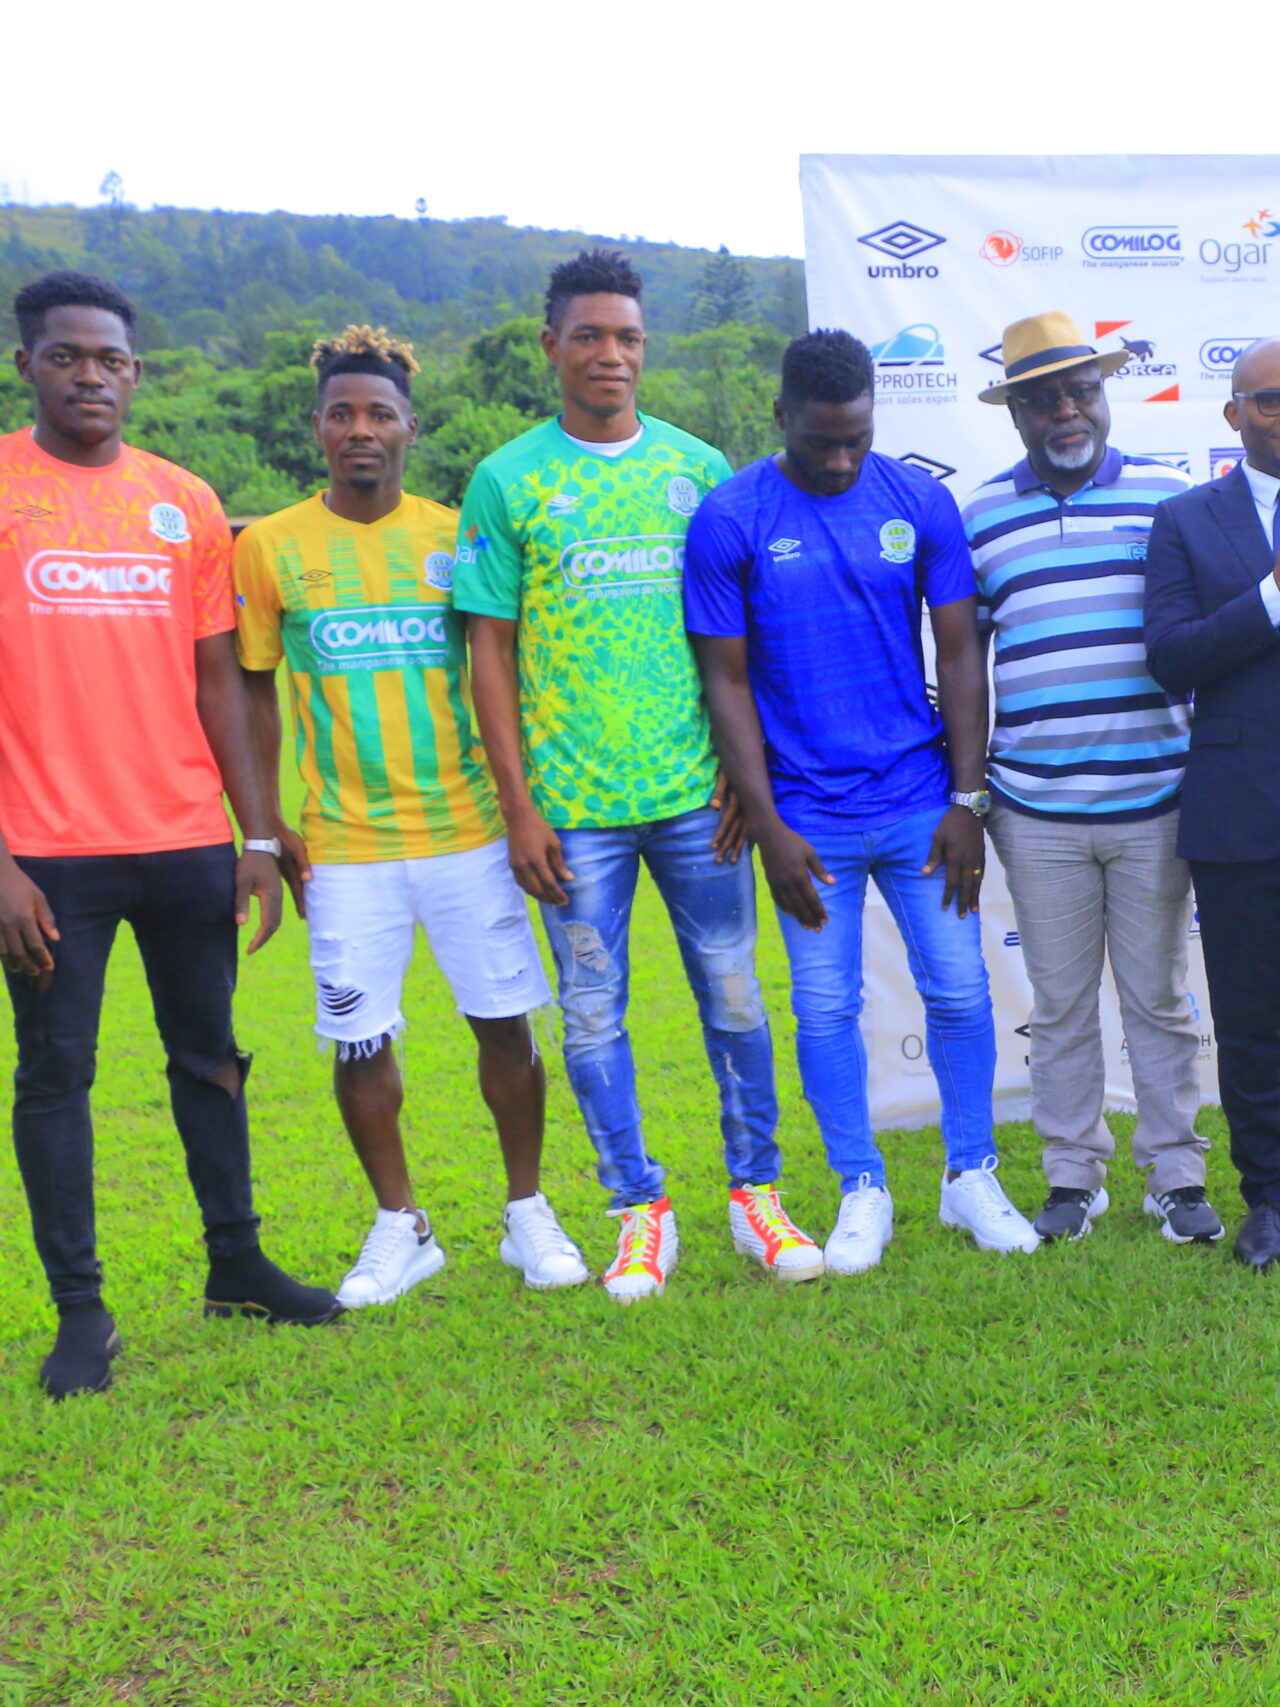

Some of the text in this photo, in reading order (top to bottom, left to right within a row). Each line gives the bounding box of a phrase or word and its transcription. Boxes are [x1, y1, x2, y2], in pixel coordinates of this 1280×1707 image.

[1090, 233, 1181, 252] COMILOG
[1022, 246, 1064, 261] SOFIP
[1199, 238, 1272, 273] Ogar
[868, 263, 939, 279] umbro
[1082, 260, 1097, 268] The
[873, 373, 957, 389] PPROTECH
[39, 562, 171, 594] COMILOG
[29, 603, 53, 615] The
[58, 604, 133, 618] manganese
[321, 616, 447, 649] COMILOG
